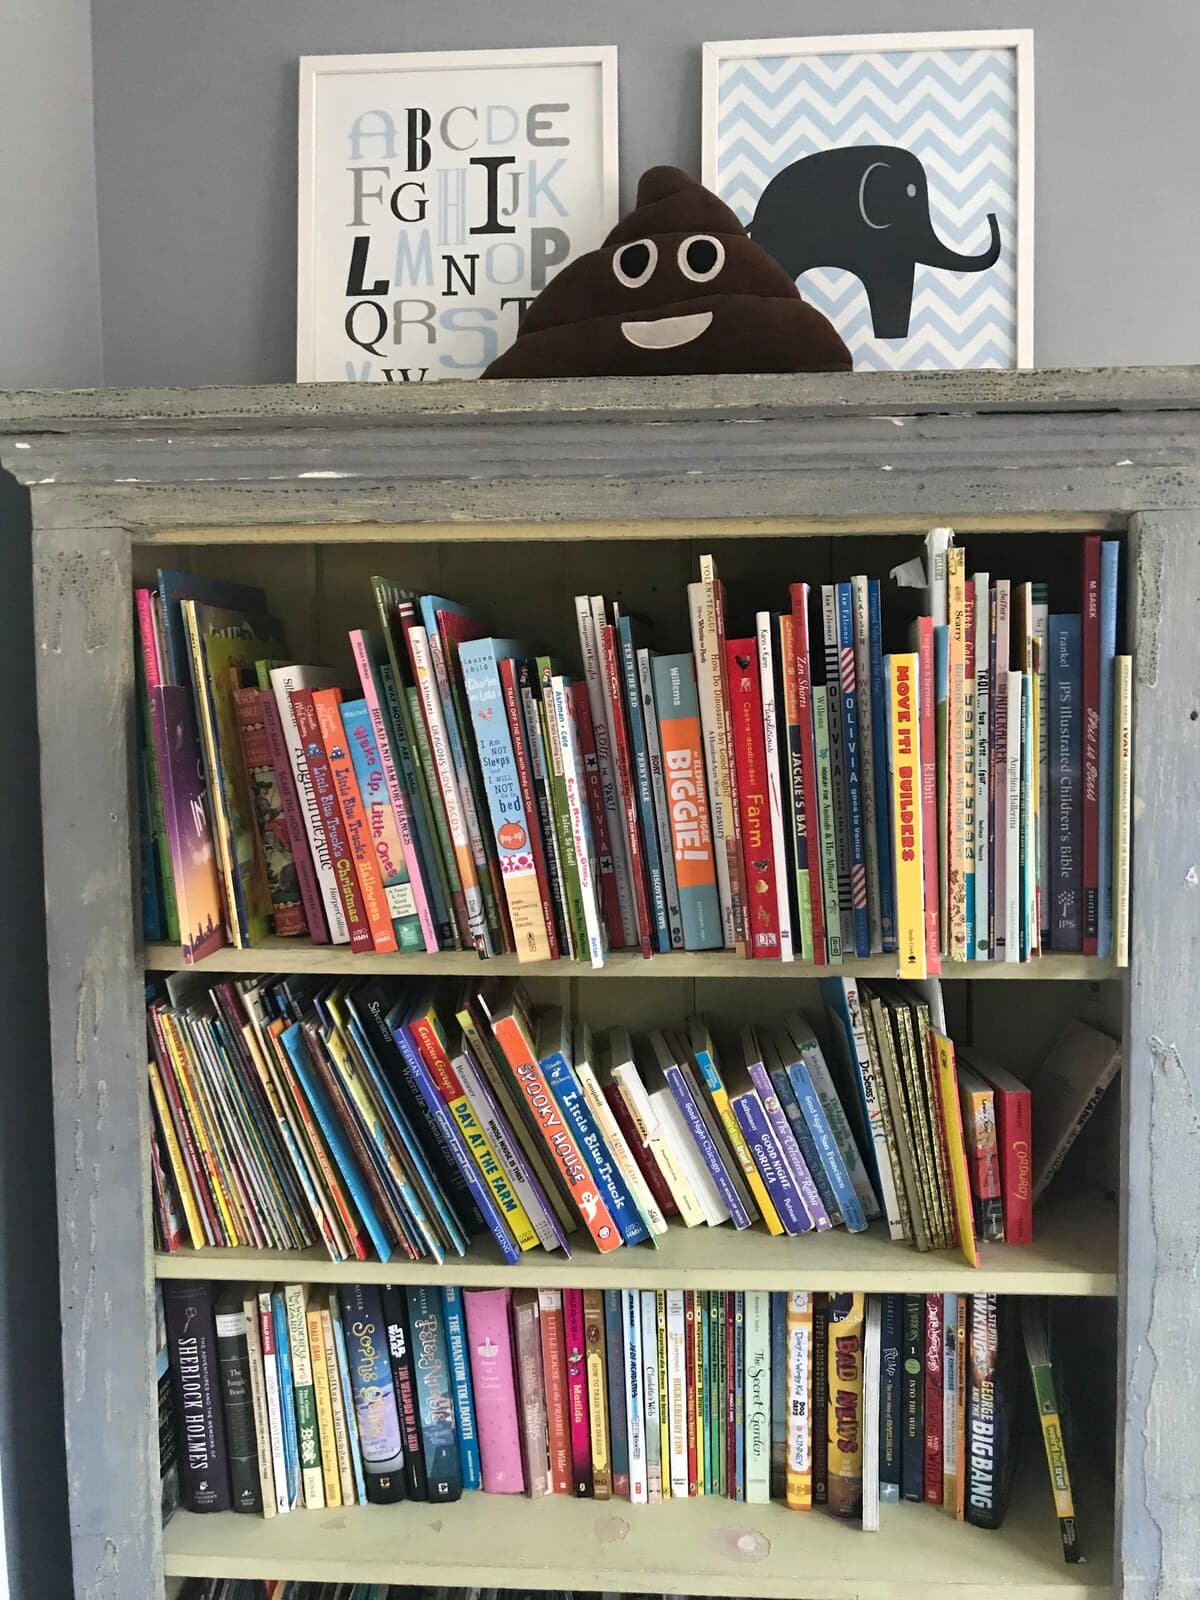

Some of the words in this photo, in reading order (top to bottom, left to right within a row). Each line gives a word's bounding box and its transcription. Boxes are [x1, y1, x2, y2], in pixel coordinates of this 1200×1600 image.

[703, 564, 712, 593] YOLEN
[1089, 580, 1096, 590] M.
[706, 599, 715, 634] TEAGUE
[841, 593, 849, 607] Ian
[842, 609, 850, 644] Falconer
[954, 610, 963, 642] Scarry
[626, 661, 633, 670] IN
[797, 656, 807, 675] Zen
[1059, 631, 1070, 667] Frankel
[670, 667, 681, 706] Willems
[798, 678, 808, 709] Shorts
[896, 665, 911, 723] MOVE
[977, 669, 990, 697] TROLL
[1058, 681, 1071, 701] JPS
[372, 708, 384, 740] BREAD
[555, 691, 566, 722] Ashman
[561, 731, 569, 748] Cole
[817, 696, 825, 729] Willems
[978, 711, 986, 725] two
[994, 695, 1008, 764] NUTCRACKER
[353, 725, 378, 765] Wake
[379, 743, 392, 761] AND
[846, 697, 858, 782] OLIVIA
[898, 728, 912, 755] IT!
[978, 738, 988, 757] three
[1060, 706, 1072, 772] Illustrated
[313, 765, 331, 793] Little
[335, 768, 353, 796] Little
[385, 765, 396, 782] JAM
[430, 725, 448, 766] DRAGONS
[442, 771, 452, 795] LOVE
[449, 801, 460, 831] TACOS
[651, 755, 661, 775] RORY
[791, 751, 805, 809] JACKIE'S
[978, 769, 987, 785] four
[1009, 756, 1019, 792] Angelina
[368, 771, 382, 796] Up,
[391, 784, 403, 802] FOR
[923, 762, 935, 803] Ribbit!
[321, 795, 333, 817] Blue
[344, 796, 357, 819] Blue
[499, 796, 521, 813] bed
[666, 749, 709, 860] BIGGIE!
[851, 788, 859, 812] goes
[898, 766, 915, 862] BUILDERS
[1009, 794, 1018, 829] Ballerina
[1060, 776, 1073, 842] Children's
[328, 817, 343, 857] Truck's
[371, 802, 384, 838] Little
[395, 804, 412, 845] FRANCES
[747, 794, 764, 847] Farm
[796, 814, 807, 838] BAT
[853, 815, 859, 825] to
[350, 820, 366, 859] Truck's
[377, 841, 398, 877] Ones
[1061, 846, 1073, 878] Bible
[337, 859, 358, 922] Christmas
[360, 862, 380, 921] Halloween
[398, 1040, 421, 1077] FREEMAN
[859, 1059, 871, 1075] Dr.
[862, 1074, 876, 1104] Seuss's
[517, 1063, 560, 1128] SPOOKY
[550, 1131, 585, 1185] HOUSE
[740, 1099, 758, 1131] Rathmann
[488, 1120, 500, 1140] WHOSE
[499, 1141, 511, 1160] HOUSE
[512, 1167, 525, 1183] THIS?
[563, 1092, 589, 1132] Little
[583, 1132, 606, 1165] Blue
[599, 1162, 625, 1210] Truck
[685, 1103, 697, 1120] Good
[693, 1121, 706, 1140] Night
[702, 1140, 721, 1173] Chicago
[805, 1095, 817, 1113] Good
[812, 1114, 826, 1134] Night
[821, 1134, 831, 1150] San
[827, 1151, 845, 1189] Francisco
[455, 1103, 476, 1129] DAY
[469, 1133, 485, 1148] AT
[479, 1150, 498, 1175] THE
[491, 1176, 517, 1212] FARM
[754, 1144, 776, 1184] GORILLA
[761, 1133, 778, 1159] GOOD
[772, 1160, 790, 1190] NIGHT,
[776, 1120, 787, 1134] The
[784, 1135, 805, 1176] Velveteen
[802, 1177, 819, 1206] Rabbit
[1012, 1141, 1028, 1200] CORDUROY
[783, 1198, 798, 1223] Putnam
[494, 1226, 511, 1253] VIKING
[309, 1321, 319, 1344] ROALD
[388, 1324, 399, 1358] WARS
[448, 1314, 459, 1334] THE
[547, 1316, 557, 1348] LITTLE
[313, 1345, 321, 1362] DAHL
[396, 1327, 406, 1358] STAR
[450, 1335, 467, 1381] PHANTOM
[754, 1352, 765, 1367] The
[835, 1335, 860, 1382] BAD
[178, 1337, 204, 1409] SHERLOCK
[550, 1350, 560, 1380] HOUSE
[593, 1377, 599, 1387] TO
[646, 1366, 655, 1401] Charlotte's
[749, 1366, 766, 1411] Secret
[981, 1380, 994, 1421] GEORGE
[457, 1384, 474, 1440] TOLLBOOTH
[554, 1403, 563, 1438] PRAIRIE
[573, 1384, 583, 1423] Matilda
[647, 1400, 656, 1417] Web
[751, 1412, 766, 1456] Garden
[836, 1390, 859, 1454] NEWS
[1047, 1426, 1059, 1452] weird
[185, 1415, 208, 1470] HOLMES
[795, 1434, 804, 1466] KINNEY
[1052, 1452, 1063, 1466] but
[557, 1449, 566, 1473] Wilder
[1055, 1467, 1066, 1489] true!
